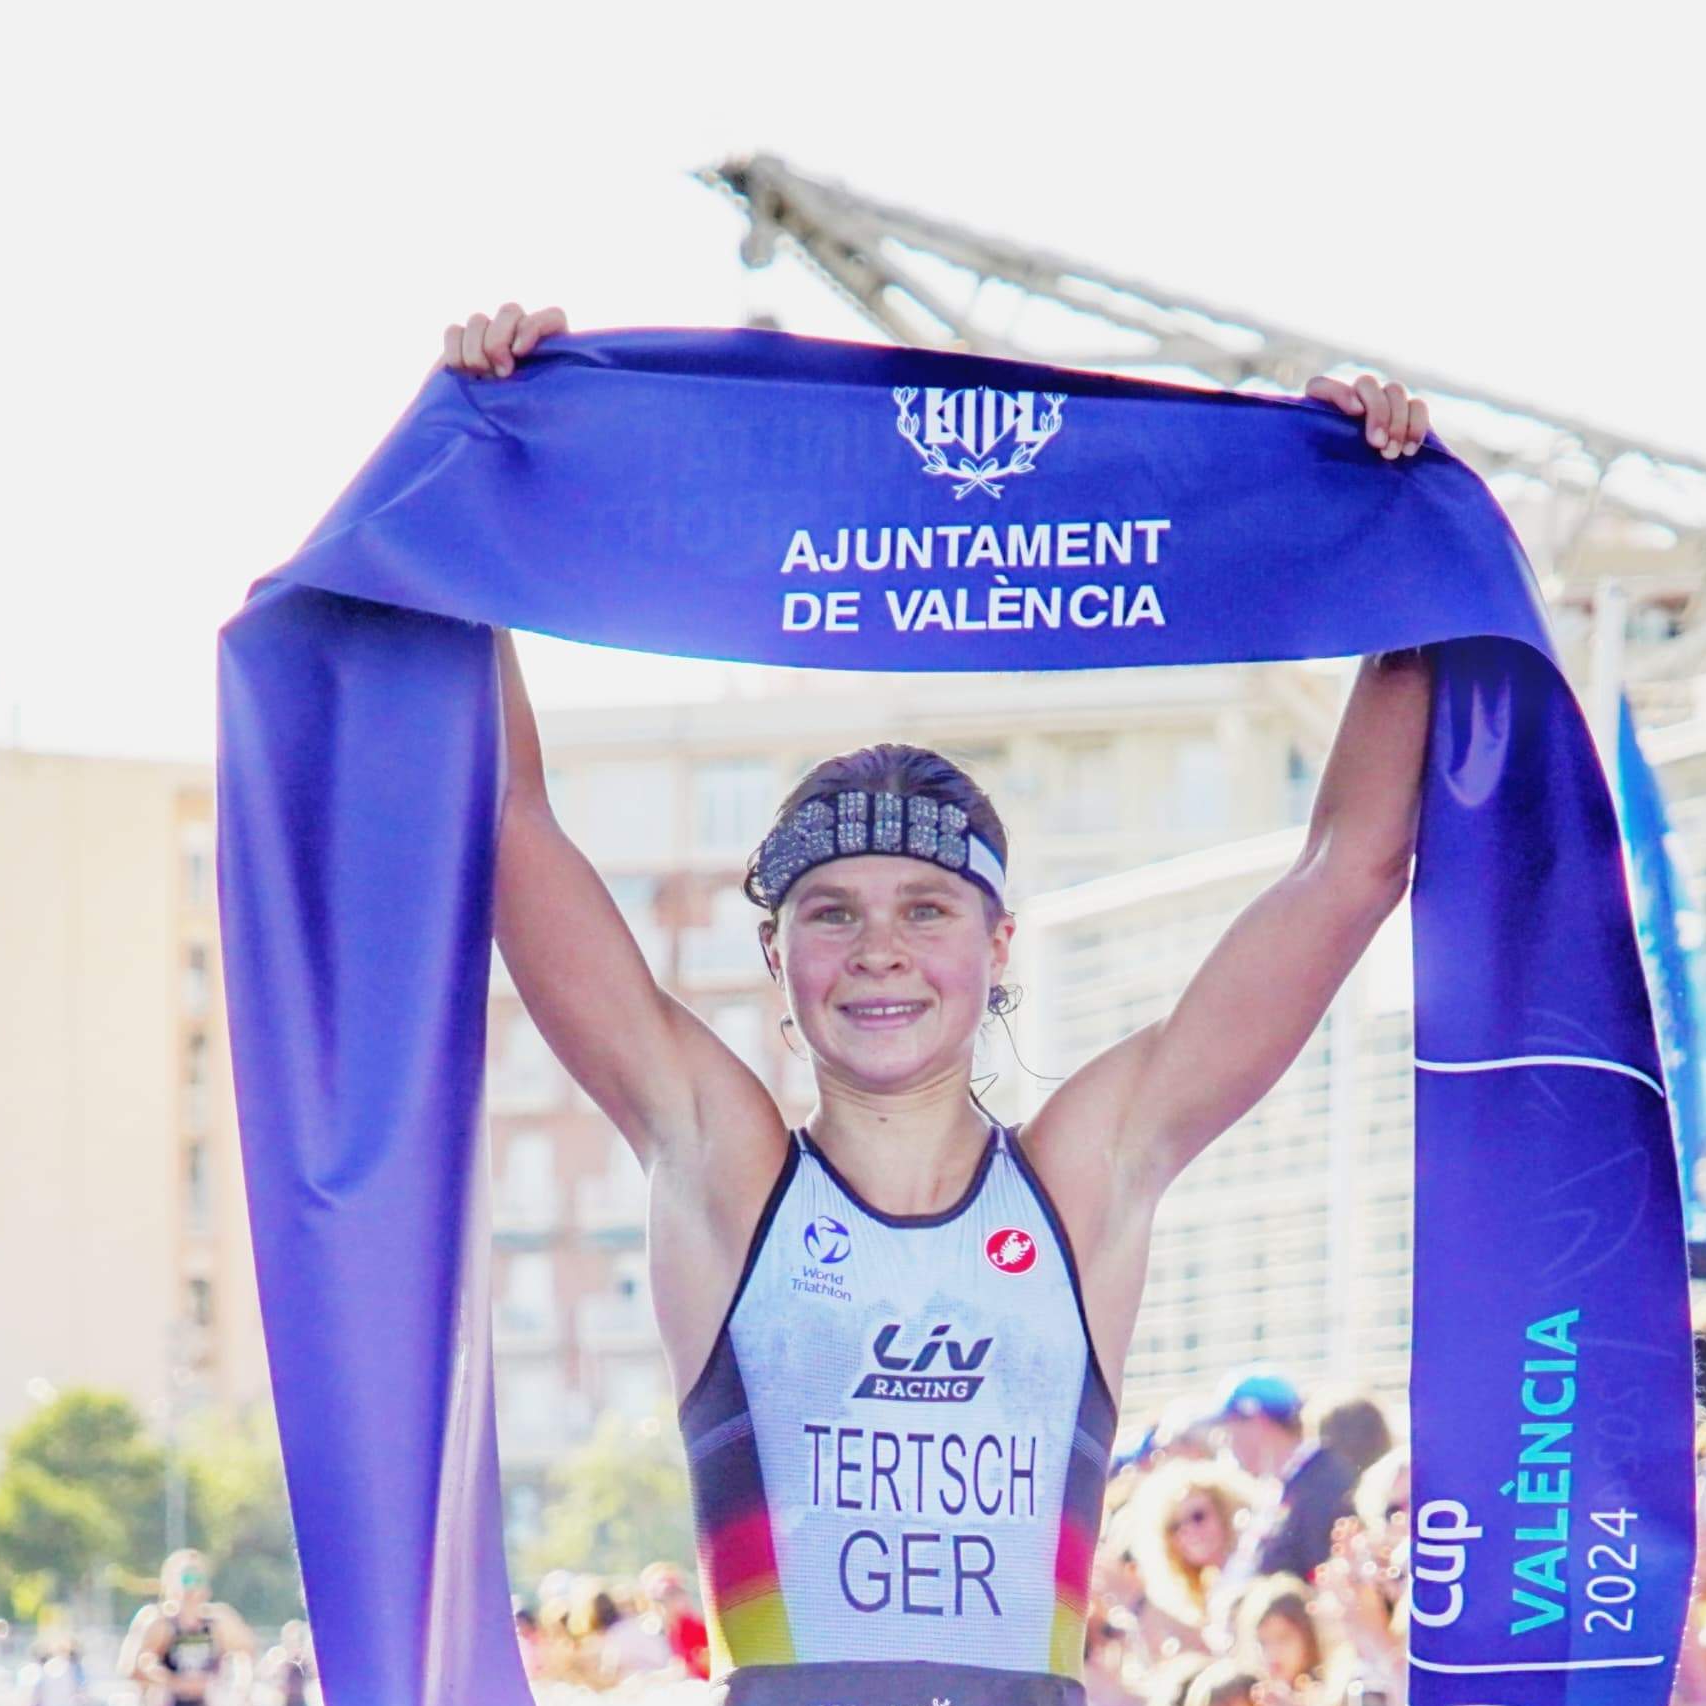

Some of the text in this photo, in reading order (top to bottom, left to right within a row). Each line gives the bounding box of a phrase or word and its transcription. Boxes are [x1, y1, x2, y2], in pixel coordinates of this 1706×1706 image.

[780, 519, 1171, 574] AJUNTAMENT
[781, 573, 1167, 632] DE VALÈNCIA
[791, 1278, 852, 1302] Triathlon
[802, 1265, 844, 1286] World
[873, 1378, 970, 1400] RACING
[804, 1424, 1037, 1517] TERTSCH
[1499, 1309, 1581, 1635] VALÈNCIA
[838, 1529, 1003, 1618] GER
[1410, 1499, 1483, 1629] Cup
[1584, 1505, 1639, 1634] 2024
